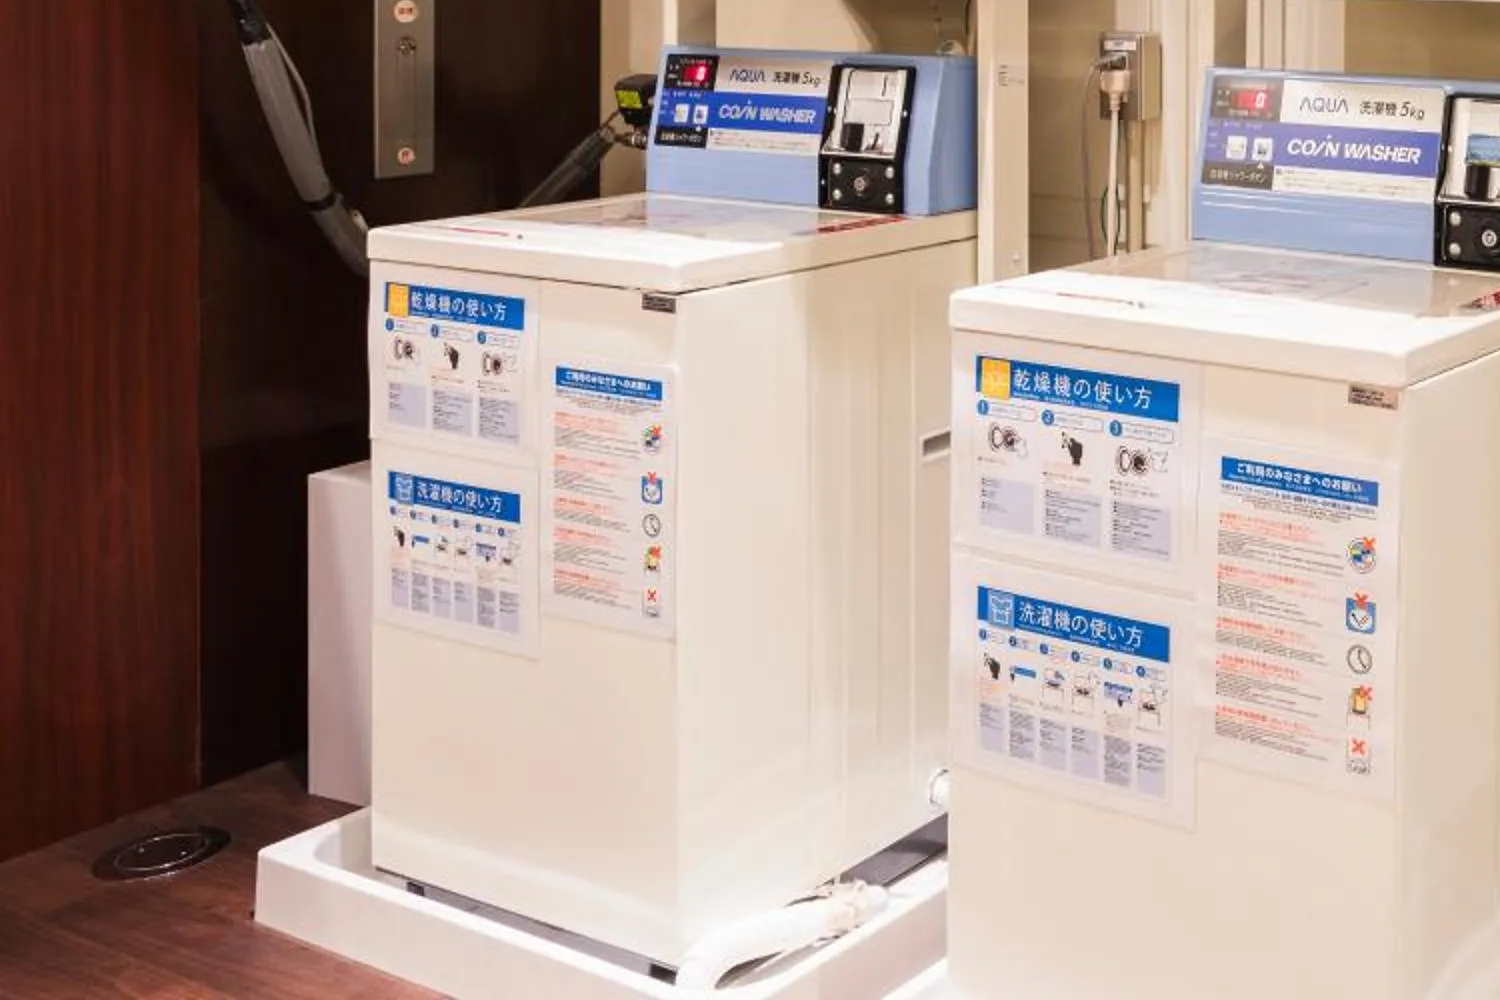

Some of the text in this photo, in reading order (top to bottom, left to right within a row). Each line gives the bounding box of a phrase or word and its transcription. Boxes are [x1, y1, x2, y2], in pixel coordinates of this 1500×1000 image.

[729, 68, 766, 83] AQUA
[801, 71, 822, 88] 5kg
[1256, 92, 1266, 108] 0
[1299, 95, 1349, 115] AQUA
[1359, 100, 1426, 121] 洗濯機 5kg
[759, 106, 816, 124] WASHER
[1343, 142, 1422, 165] WASHER
[411, 290, 507, 322] 乾燥機の使い方
[1013, 369, 1153, 411] 乾燥機の使い方
[416, 481, 502, 514] 洗濯機の使い方
[1019, 602, 1145, 649] 洗濯機の使い方
